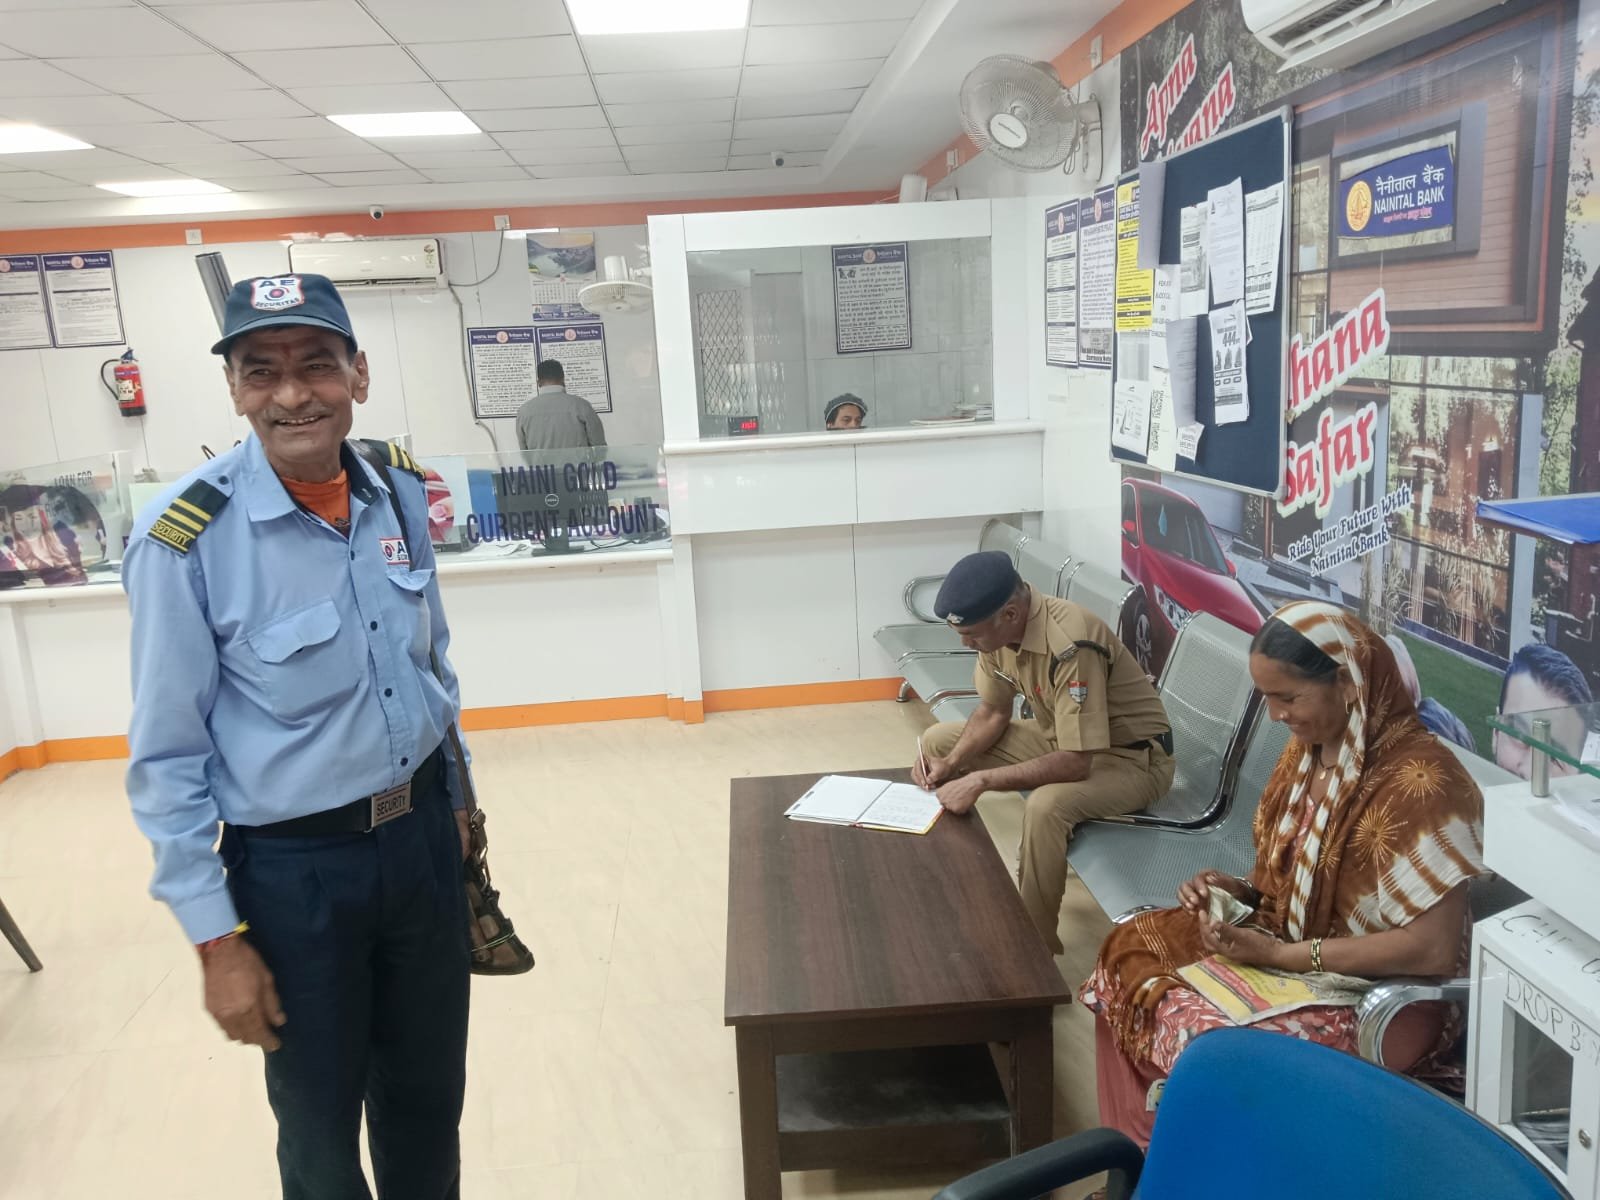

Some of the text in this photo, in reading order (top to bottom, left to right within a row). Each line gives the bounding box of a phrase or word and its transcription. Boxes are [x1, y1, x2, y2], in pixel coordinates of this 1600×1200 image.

[1141, 35, 1196, 159] Apna
[1374, 186, 1445, 215] NAINITAL BANK
[1375, 164, 1445, 196] नैनीताल बैंक
[501, 464, 558, 496] NAINI
[152, 521, 191, 546] SECURITY
[466, 503, 660, 544] CURRENT ACCOUNT
[1289, 486, 1410, 560] Ride Your Future With
[1311, 525, 1389, 575] Nainital Bank
[1506, 970, 1563, 1035] DROP
